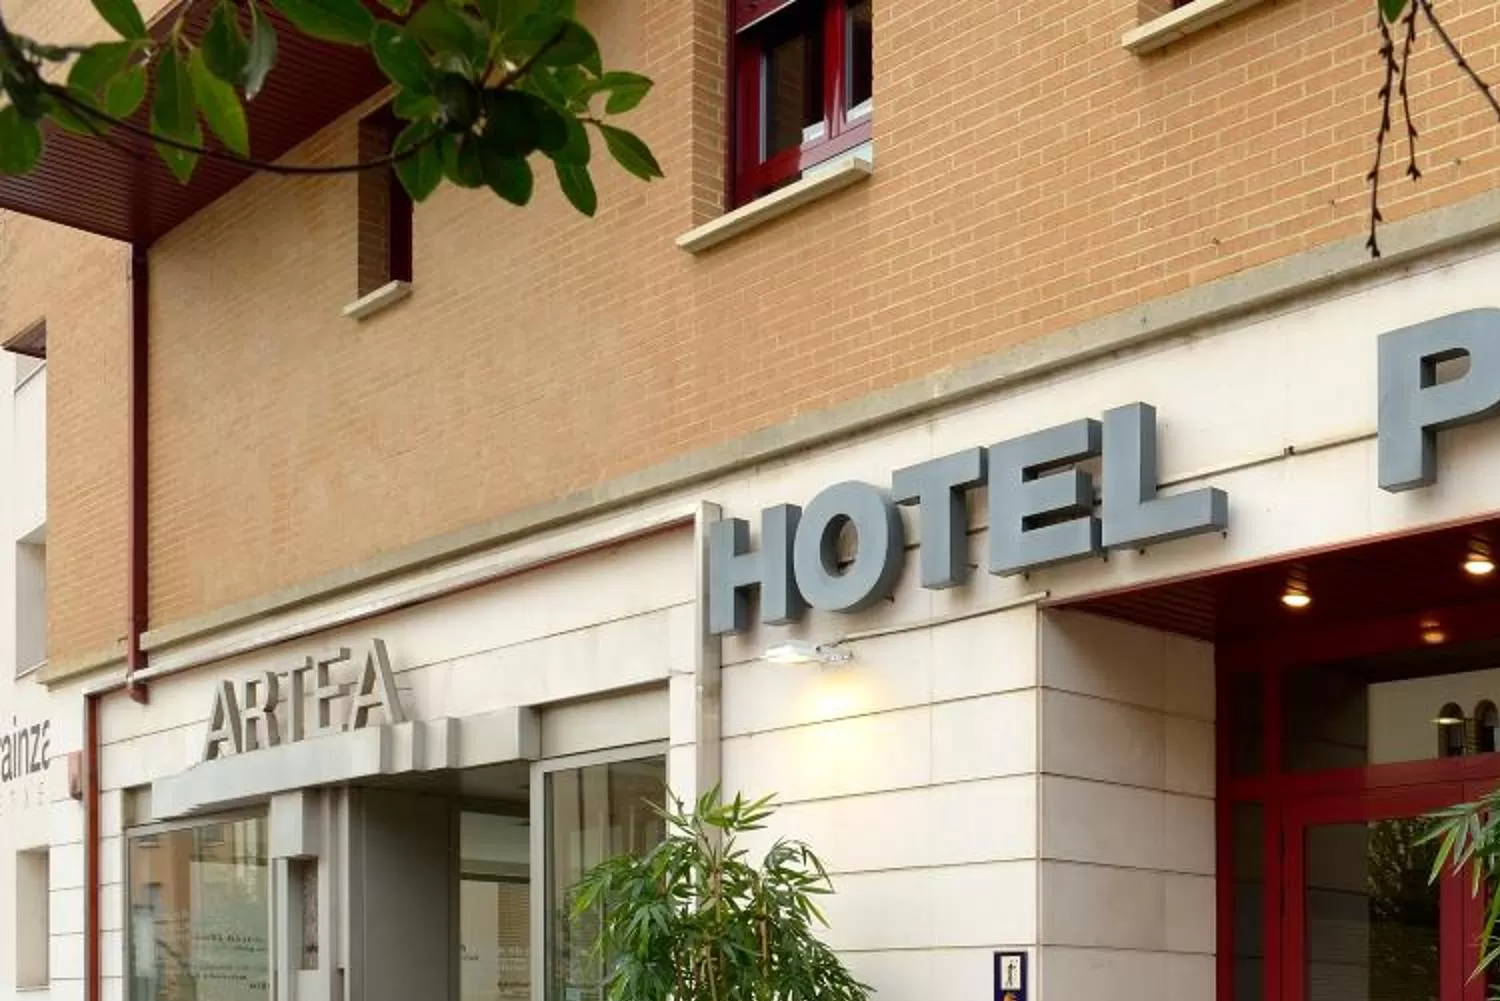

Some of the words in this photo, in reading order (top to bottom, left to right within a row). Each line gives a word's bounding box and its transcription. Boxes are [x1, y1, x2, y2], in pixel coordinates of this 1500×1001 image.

[709, 401, 1228, 635] HOTEL
[0, 715, 51, 783] ainza
[201, 637, 408, 761] ARTEA
